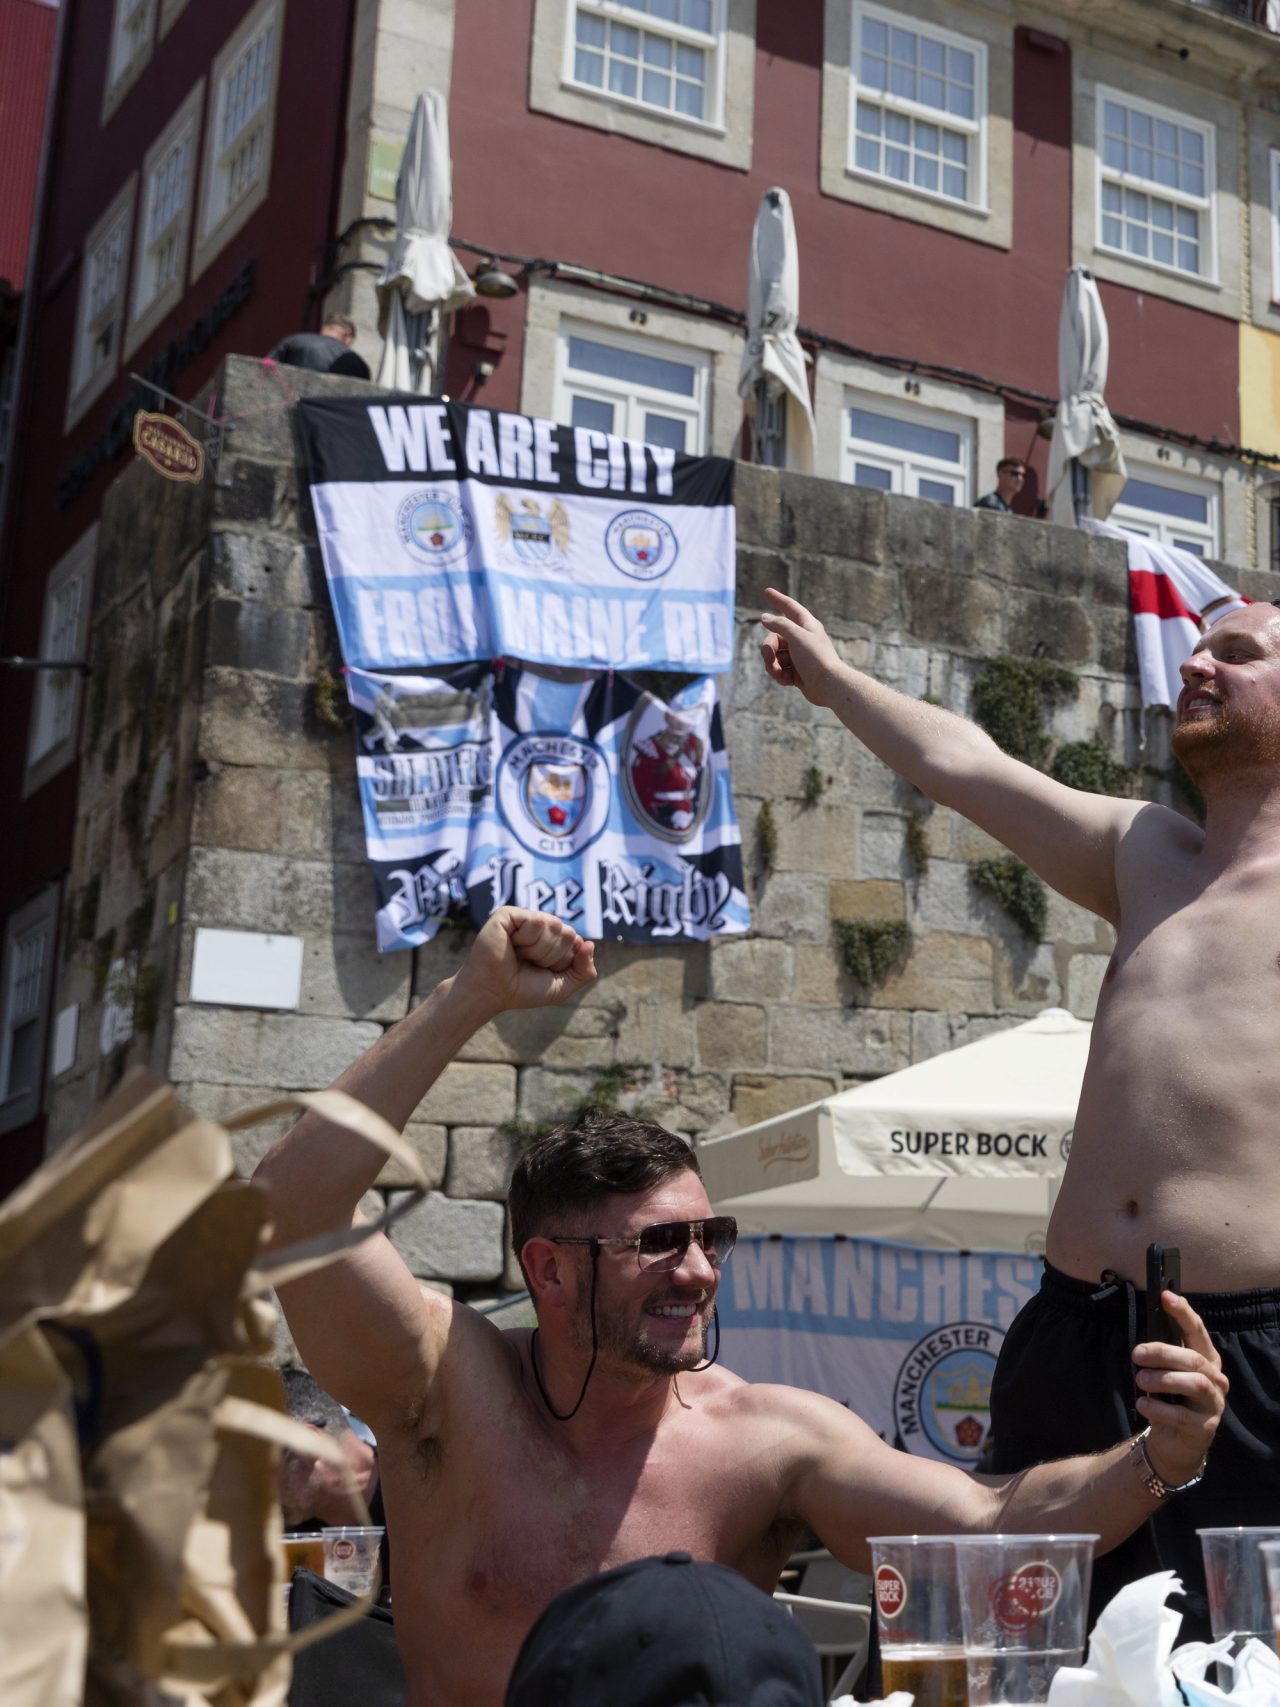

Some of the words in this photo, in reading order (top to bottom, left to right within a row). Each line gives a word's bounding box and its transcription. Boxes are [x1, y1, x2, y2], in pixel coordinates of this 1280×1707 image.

[367, 405, 456, 472] WE
[465, 408, 560, 483] ARE
[574, 425, 676, 497] CITY
[498, 584, 651, 663] MAINE
[664, 601, 729, 665] RD
[538, 837, 577, 852] CITY
[489, 857, 585, 921] Lee
[601, 857, 732, 936] Rigby
[891, 1131, 970, 1156] SUPER
[976, 1132, 1048, 1158] BOCK
[899, 1328, 991, 1436] MANCHESTER
